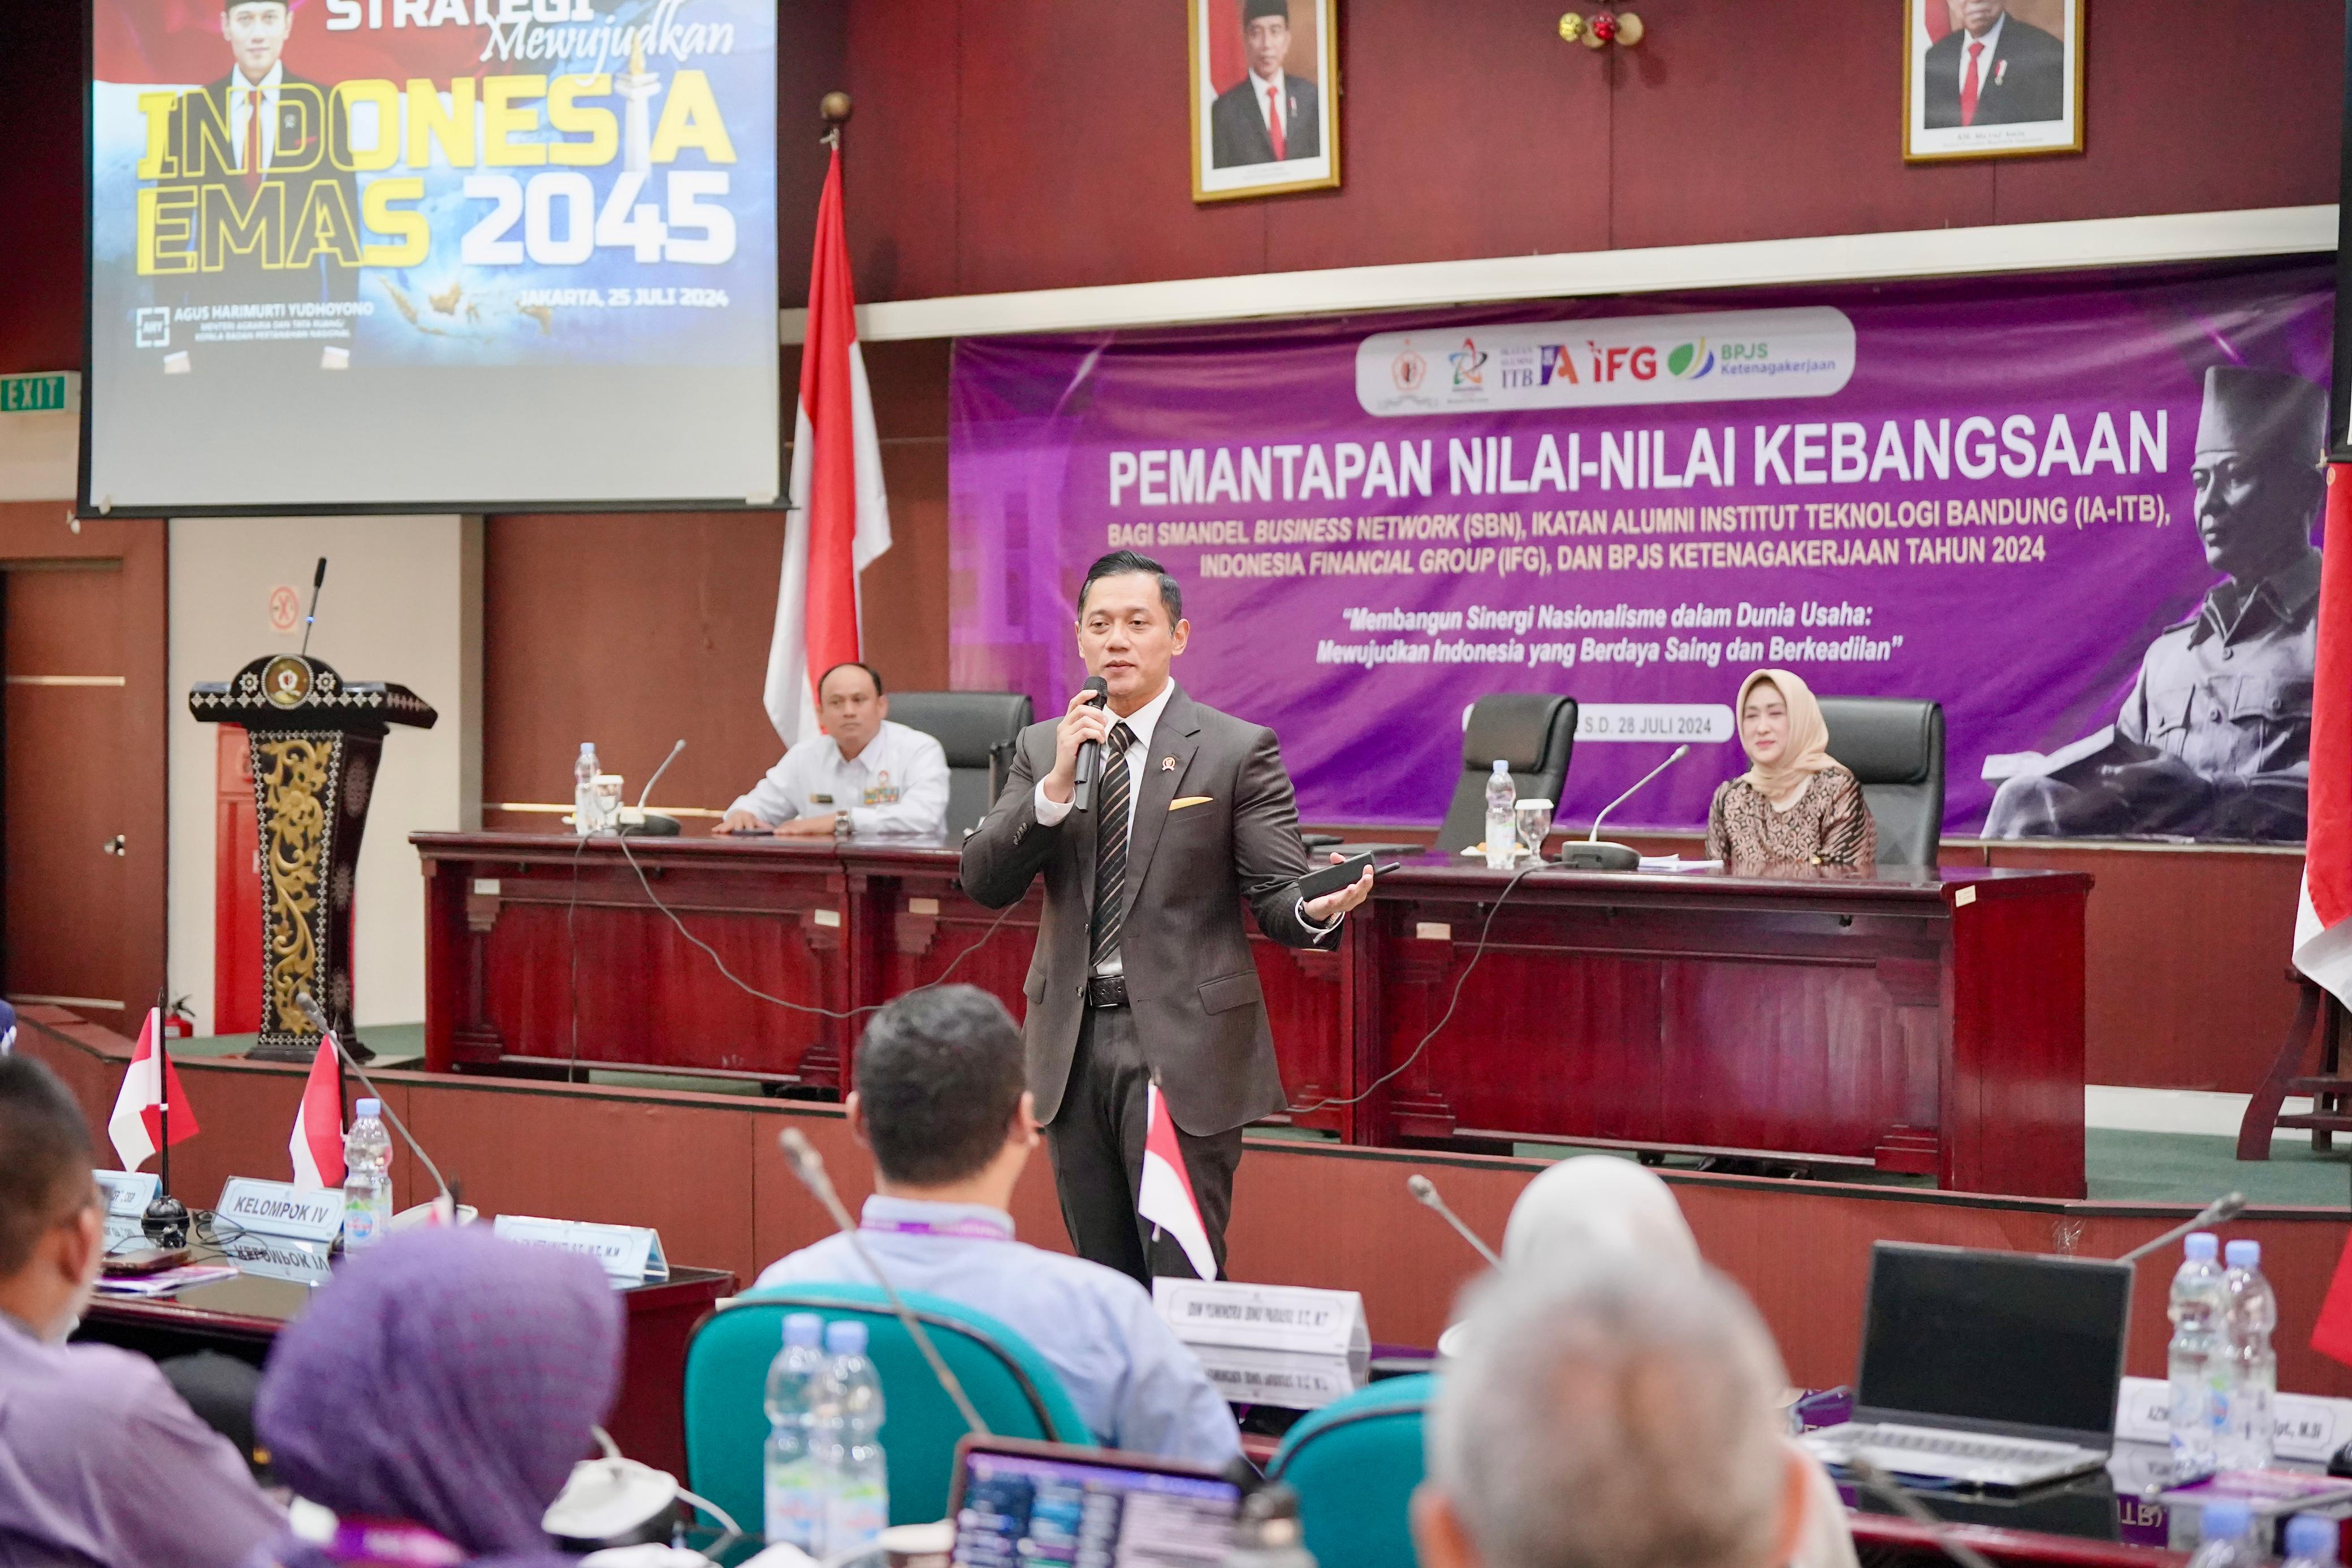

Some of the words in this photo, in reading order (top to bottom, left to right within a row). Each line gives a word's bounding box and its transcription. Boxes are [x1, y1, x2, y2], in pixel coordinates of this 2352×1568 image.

[479, 0, 734, 86] Mewujudkan
[137, 177, 430, 276] EMAS
[461, 171, 737, 266] 2045
[174, 307, 210, 322] AGUS
[212, 304, 285, 320] HARIMURTI
[288, 301, 375, 317] YUDHOYONO
[520, 288, 604, 308] JAKARTA,
[608, 288, 632, 307] 25
[634, 287, 675, 306] JULI
[680, 288, 729, 307] 2024
[1720, 343, 1769, 361] BPJS
[1720, 358, 1835, 376] Ketenagakerjaan
[7, 378, 58, 410] EXIT
[1502, 368, 1533, 389] ITB
[1109, 438, 1432, 506] PEMANTAPAN
[1449, 426, 1735, 496] NILAI-NILAI
[1754, 409, 2168, 486] KEBANGSAAN
[1108, 523, 1154, 547] BAGI
[1158, 520, 1250, 546] SMANDEL
[1253, 517, 1352, 544] BUSINESS
[1357, 514, 1460, 541] NETWORK
[1464, 511, 1525, 543] (SBN),
[1531, 509, 1608, 538] IKATAN
[1611, 506, 1695, 535] ALUMNI
[1700, 503, 1799, 533] INSTITUT
[1804, 500, 1940, 530] TEKNOLOGI
[1946, 496, 2068, 527] BANDUNG
[2074, 493, 2171, 530] (IA-ITB),
[1200, 553, 1306, 578] INDONESIA
[1309, 549, 1416, 575] FINANCIAL
[1419, 546, 1496, 574] GROUP
[1497, 545, 1552, 578] (IFG),
[1557, 544, 1604, 571] DAN
[1607, 542, 1664, 569] BPJS
[1669, 537, 1899, 568] KETENAGAKERJAAN
[1905, 536, 1986, 565] TAHUN
[1991, 534, 2046, 563] 2024
[1466, 604, 1535, 636] Sinergi
[1537, 603, 1667, 630] Nasionalisme
[1671, 602, 1732, 628] dalam
[1736, 601, 1796, 627] Dunia
[1800, 601, 1873, 627] Usaha:
[1316, 639, 1430, 669] Mewujudkan
[1432, 638, 1525, 663] Indonesia
[1527, 641, 1576, 668] yang
[1580, 636, 1660, 668] Berdaya
[1664, 636, 1722, 668] Saing
[1726, 635, 1765, 661] dan
[1618, 716, 1635, 734] 28
[1640, 716, 1672, 734] JULI
[1677, 716, 1712, 734] 2024
[234, 1195, 307, 1220] KELOMPOK
[309, 1206, 330, 1223] IV
